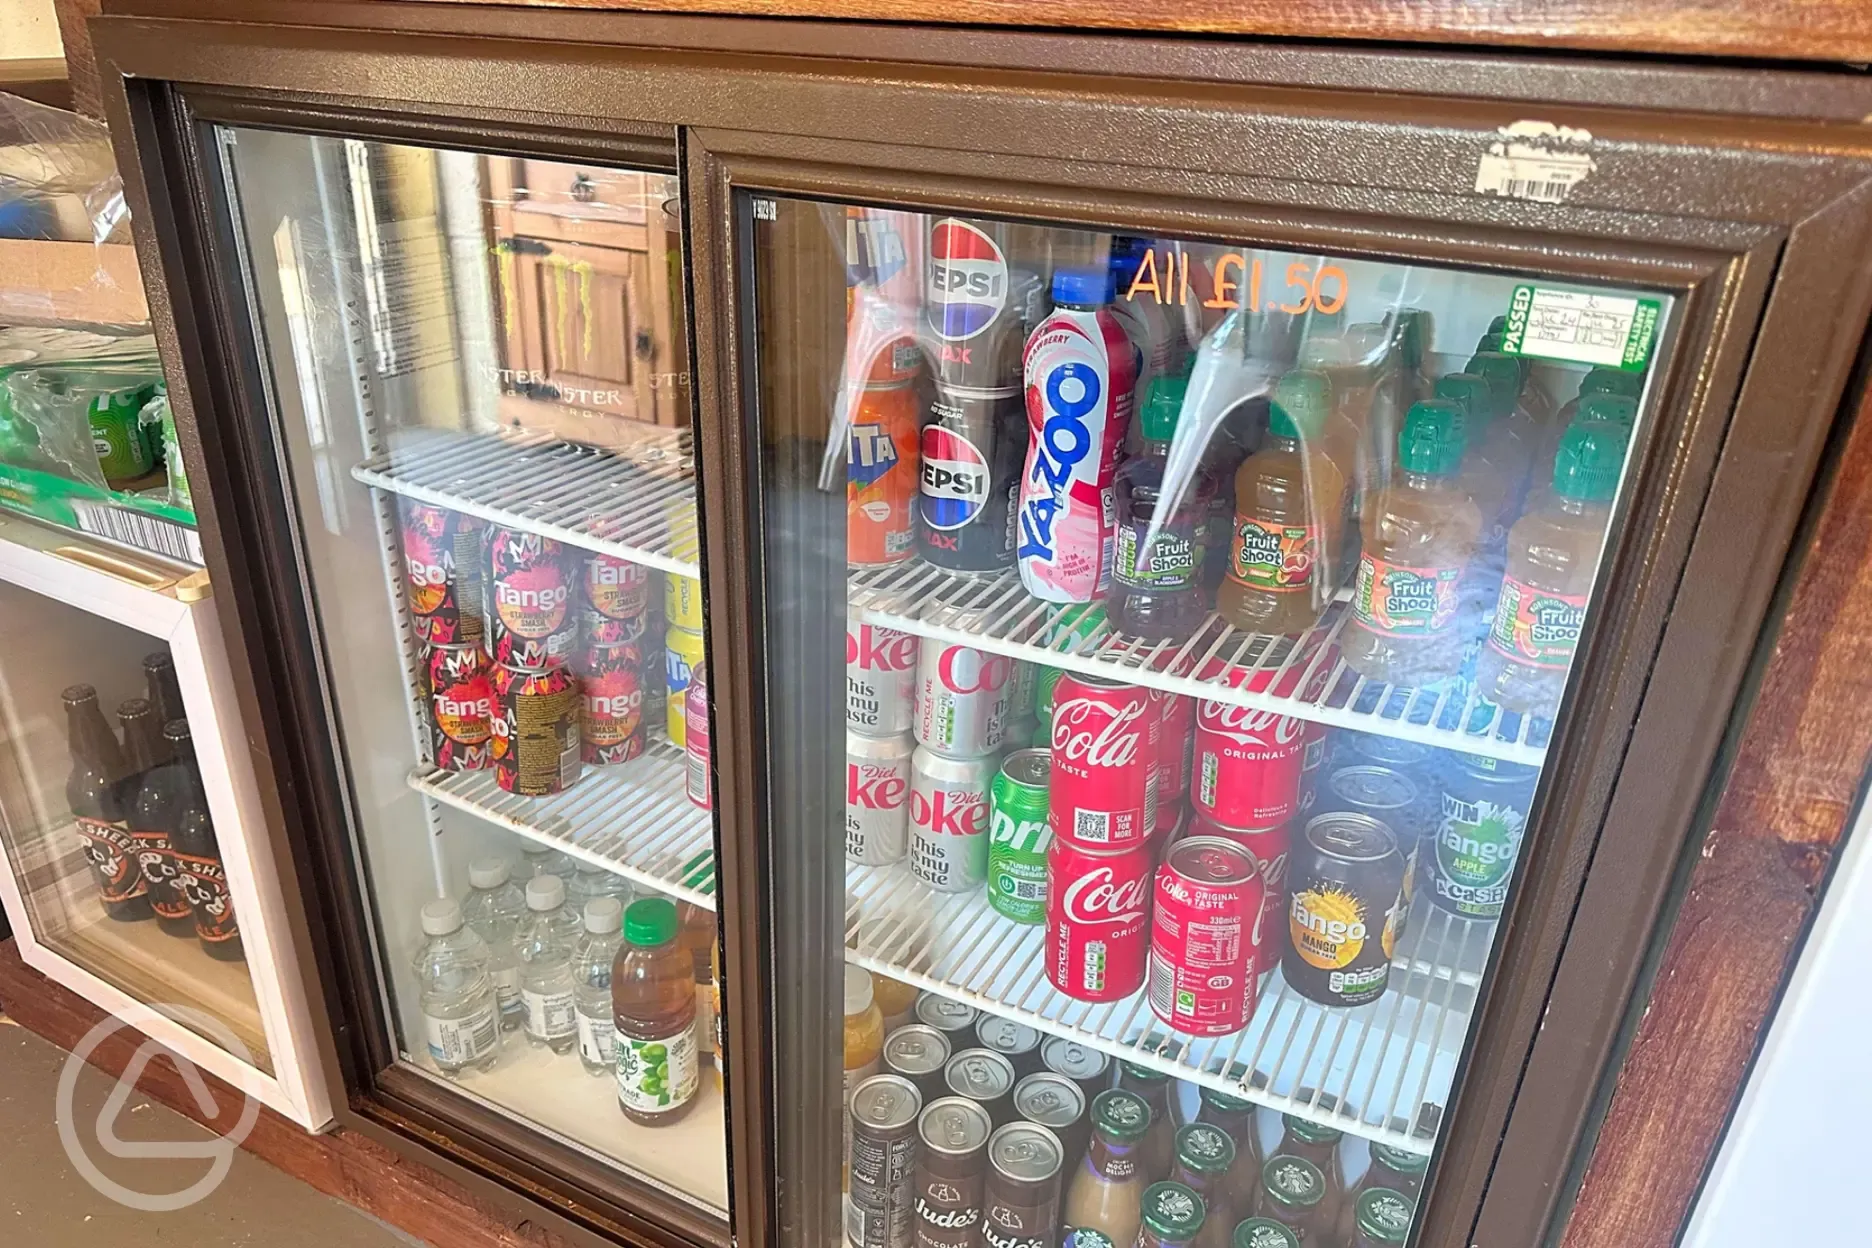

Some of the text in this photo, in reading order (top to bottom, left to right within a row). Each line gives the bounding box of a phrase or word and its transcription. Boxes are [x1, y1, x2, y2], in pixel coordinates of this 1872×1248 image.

[930, 264, 1001, 298] EPSI
[1126, 248, 1349, 314] All £1.50
[1503, 287, 1532, 353] PASSED
[938, 345, 972, 364] AX
[938, 408, 963, 419] SUGAR
[922, 463, 984, 495] EPSI
[1156, 540, 1190, 556] Fruit
[1246, 534, 1278, 550] Fruit
[1152, 554, 1192, 571] Shoot
[1242, 549, 1281, 565] Shoot
[494, 580, 567, 611] Tango
[1393, 581, 1433, 596] Fruit
[1388, 598, 1436, 611] Shoot
[1541, 609, 1584, 625] Fruit
[1534, 625, 1578, 640] Shoo
[847, 676, 875, 697] his
[433, 694, 491, 718] Tang
[922, 679, 933, 741] RECYCLE ME
[1052, 698, 1148, 767] Cola
[1224, 747, 1285, 761] ORIGINAL
[861, 764, 897, 778] Diet
[1057, 760, 1089, 779] TASTE
[947, 790, 984, 804] Diet
[1116, 814, 1132, 823] SCAN
[1442, 792, 1480, 825] WIN
[989, 800, 1054, 853] pri
[1115, 830, 1132, 839] MORE
[1117, 822, 1130, 831] FOR
[86, 824, 135, 854] SHEEP
[913, 833, 946, 859] This
[1441, 822, 1516, 865] Tango
[910, 861, 949, 886] taste
[921, 855, 950, 875] my
[1453, 857, 1487, 873] APPLE
[1161, 875, 1239, 901] Coke ORIGINAL
[1194, 899, 1225, 909] TASTE
[1456, 902, 1502, 915] STAS
[1210, 916, 1233, 925] 330ml
[1291, 892, 1367, 944] Tango
[1303, 932, 1337, 953] MANGO
[1058, 921, 1068, 987] RECYCLE ME
[1242, 976, 1254, 1023] RECYCLE
[914, 1197, 979, 1228] Jude's
